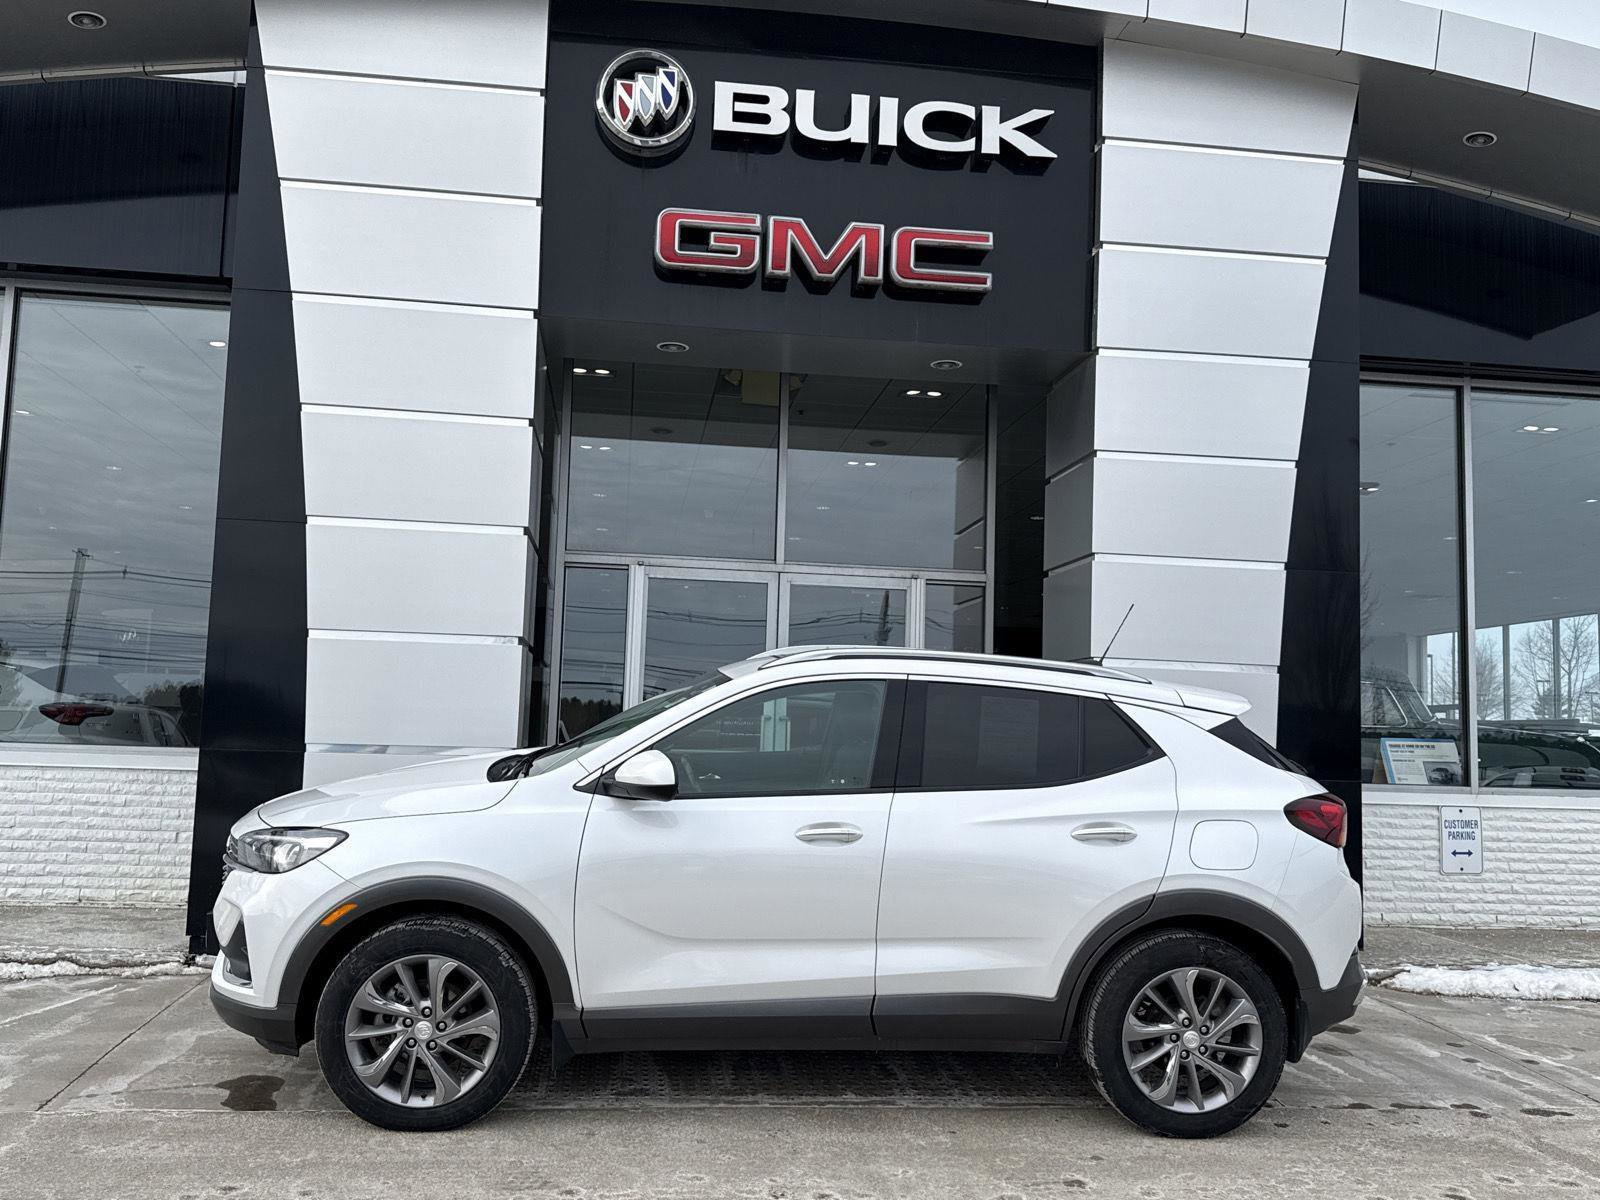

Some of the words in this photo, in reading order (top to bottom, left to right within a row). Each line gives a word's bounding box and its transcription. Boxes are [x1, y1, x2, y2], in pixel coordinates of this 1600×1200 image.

[713, 80, 1058, 159] BUICK
[655, 207, 994, 292] GMC
[1443, 819, 1479, 830] CUSTOMER
[1447, 831, 1476, 841] PARKING
